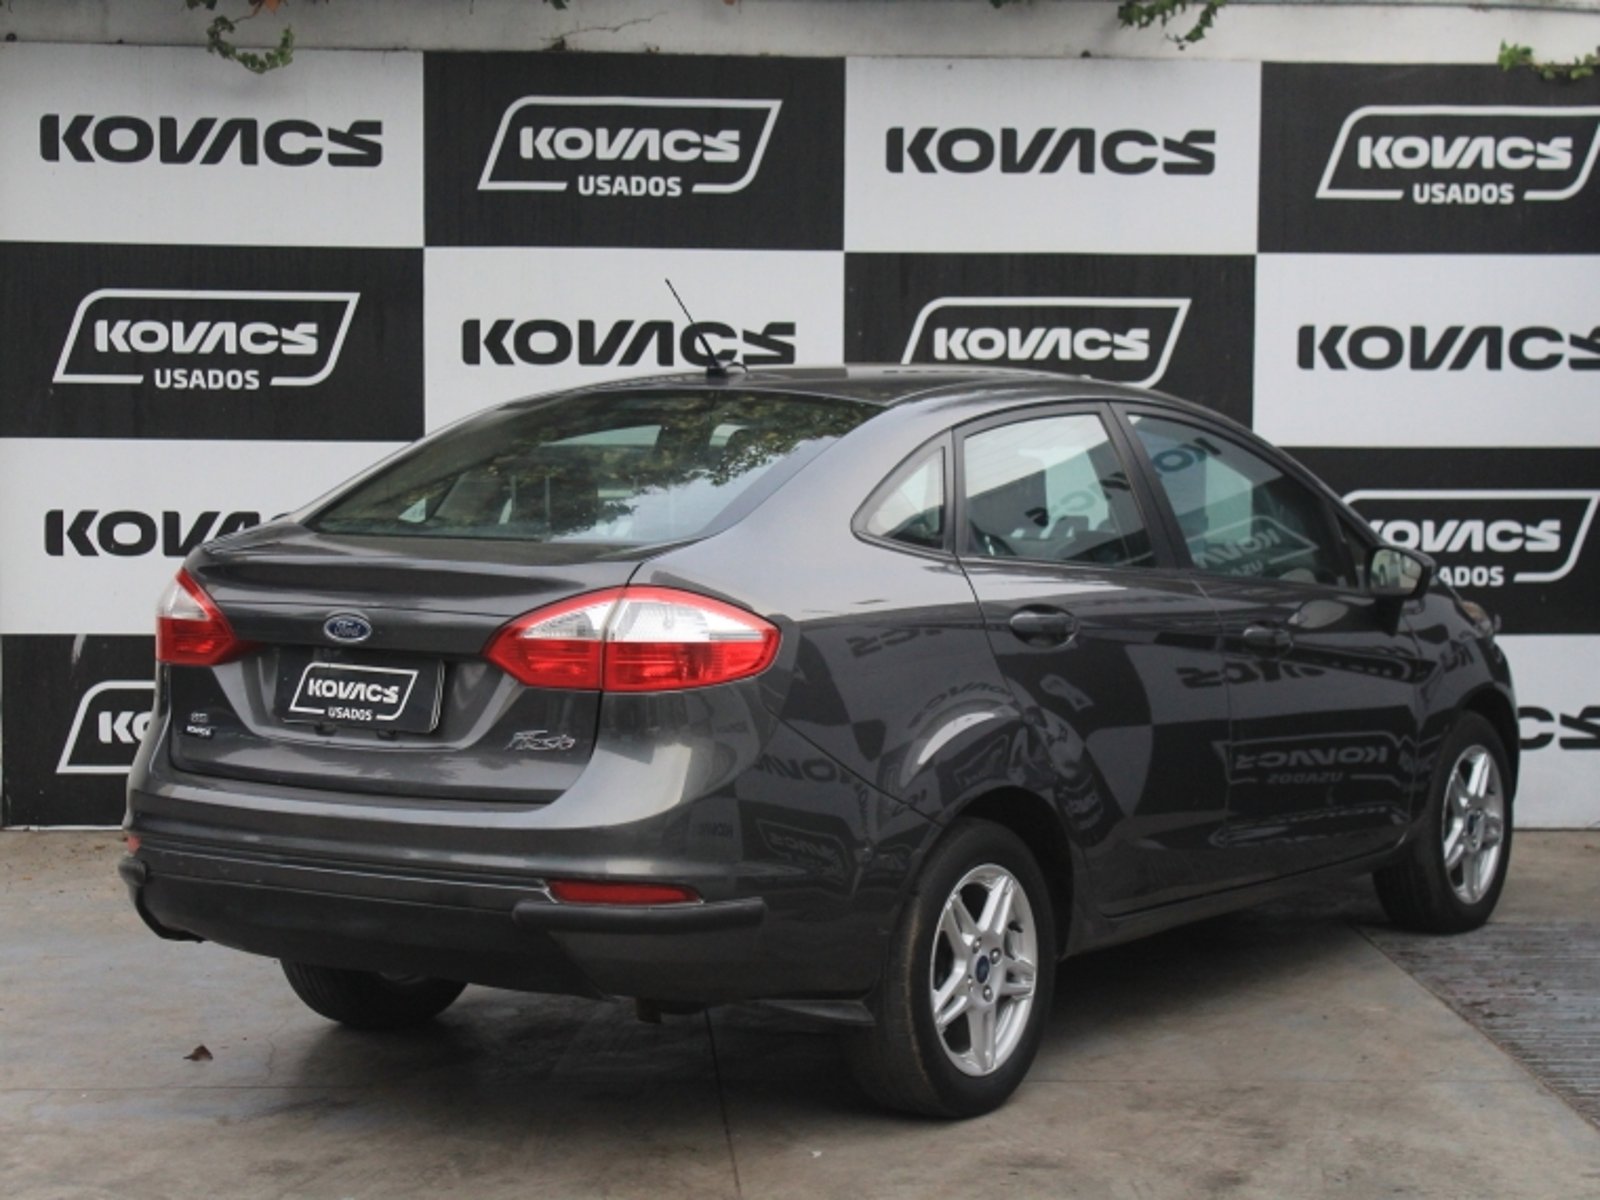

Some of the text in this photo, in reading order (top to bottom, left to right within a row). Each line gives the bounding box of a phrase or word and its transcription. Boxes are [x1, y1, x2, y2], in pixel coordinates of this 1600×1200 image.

[40, 114, 382, 168] KOVACS
[519, 126, 740, 163] KOVACS
[886, 126, 1216, 176] KOVACS
[1357, 136, 1572, 170] KOVACS
[578, 175, 682, 197] USADOS
[1412, 182, 1515, 205] USADOS
[94, 319, 318, 355] KOVACS
[462, 319, 796, 366] KOVACS
[933, 327, 1150, 361] KOVACS
[154, 368, 260, 391] USADOS
[1369, 519, 1561, 552] OVACS
[1438, 566, 1505, 587] ADOS
[307, 677, 400, 704] KOVACS
[327, 706, 373, 721] USADOS
